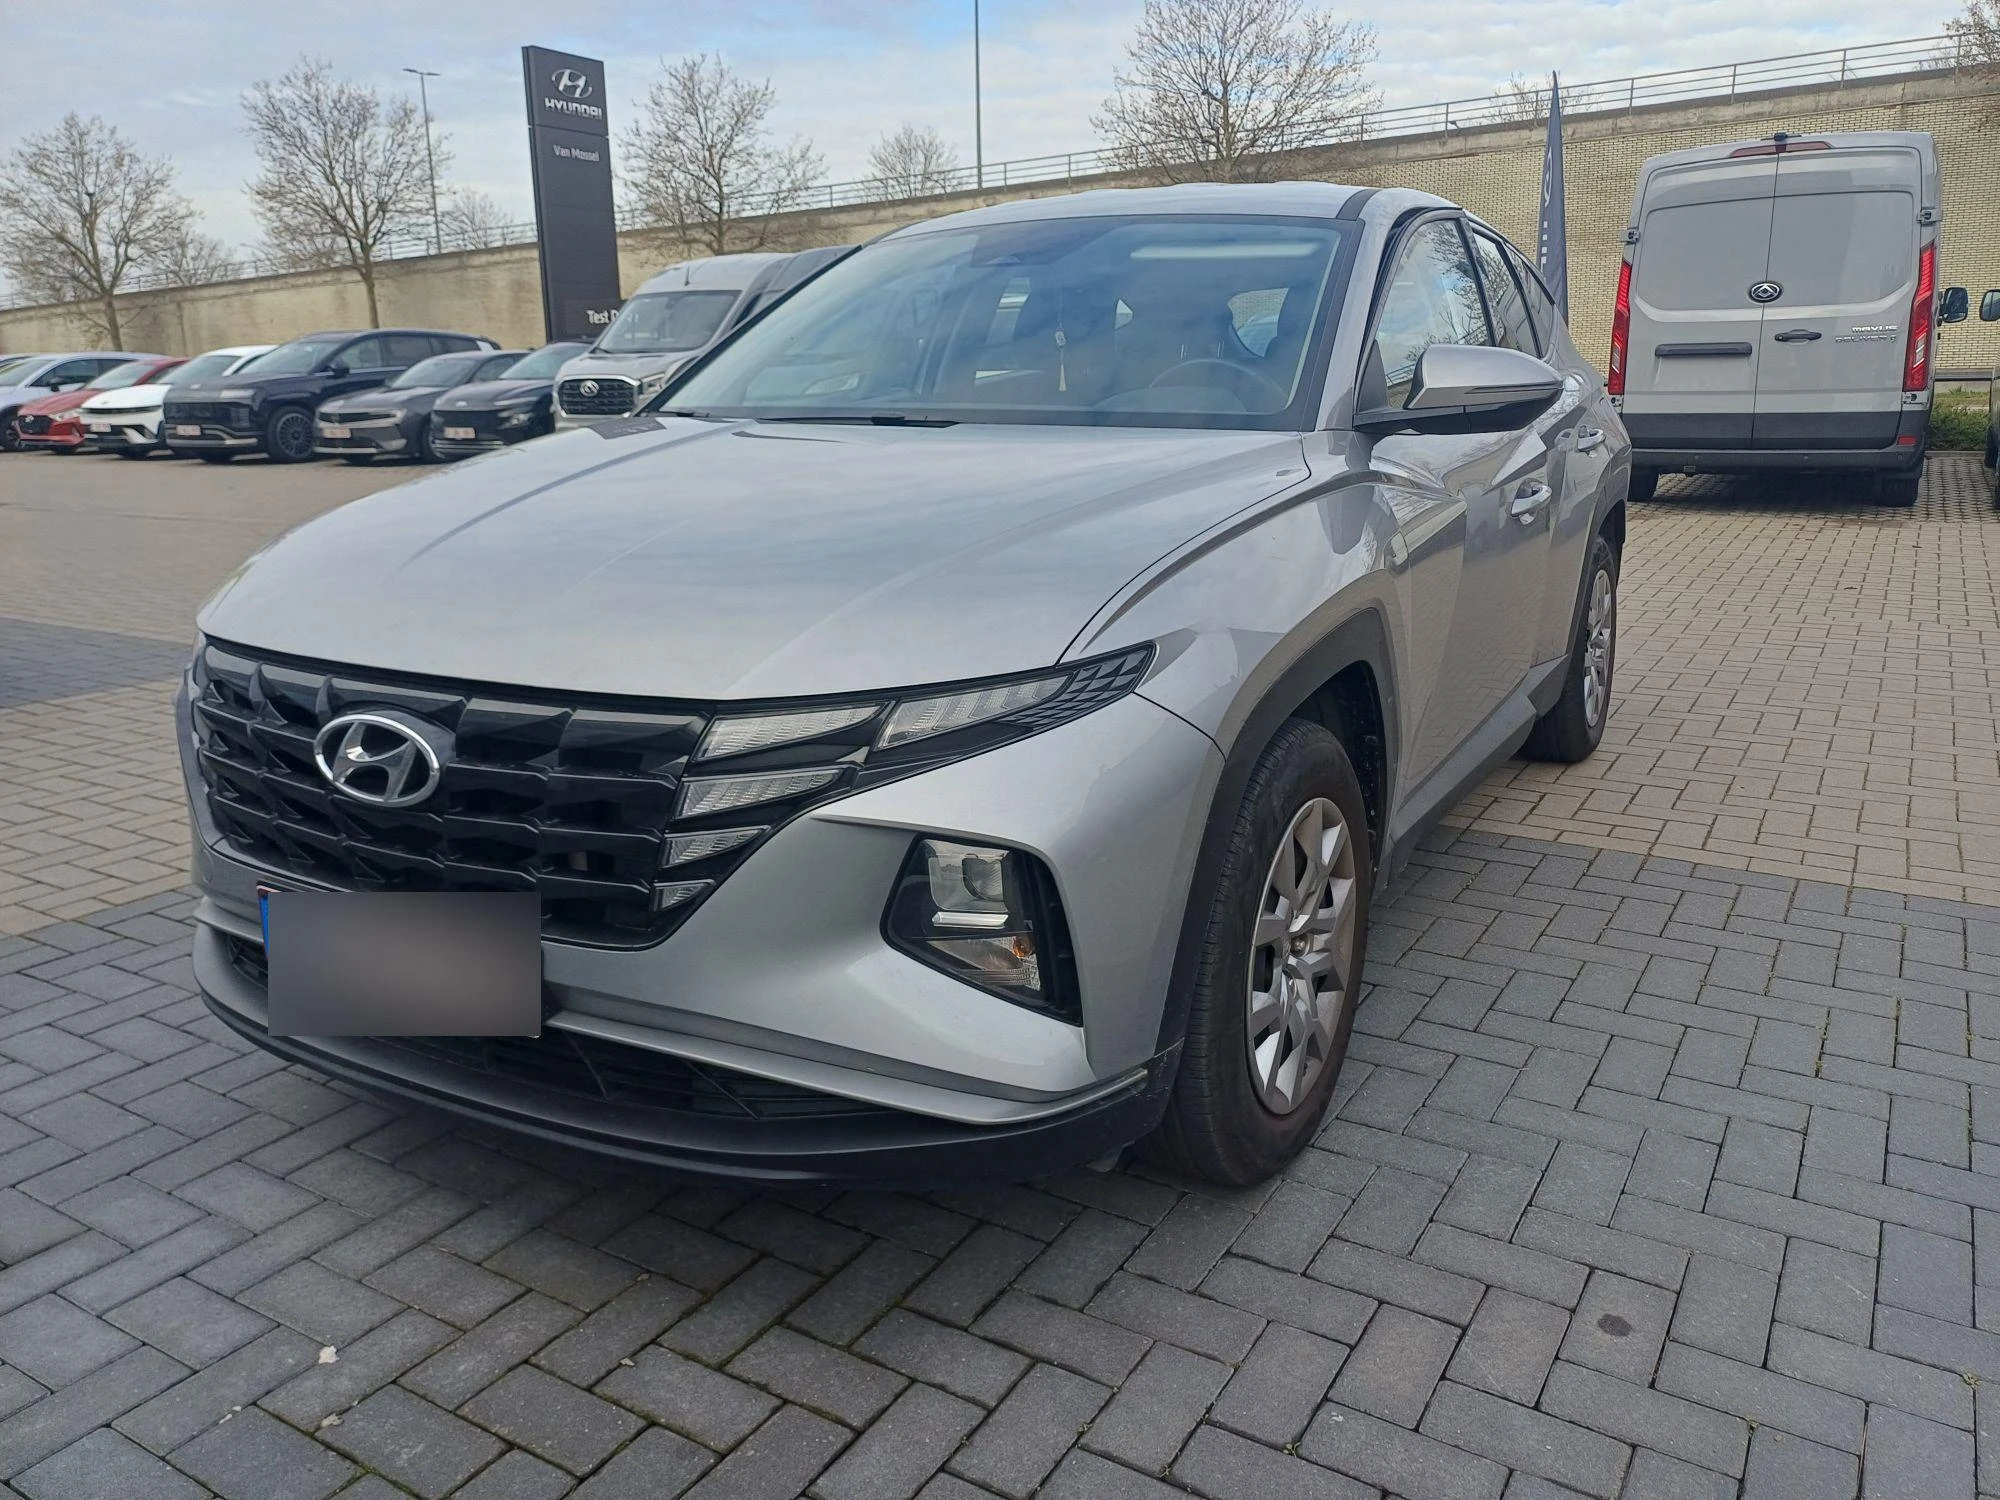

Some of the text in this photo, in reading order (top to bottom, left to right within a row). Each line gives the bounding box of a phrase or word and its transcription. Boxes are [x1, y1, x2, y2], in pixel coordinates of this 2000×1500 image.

[544, 97, 602, 119] HYUNDAI
[553, 144, 571, 158] Van
[586, 309, 610, 324] Test
